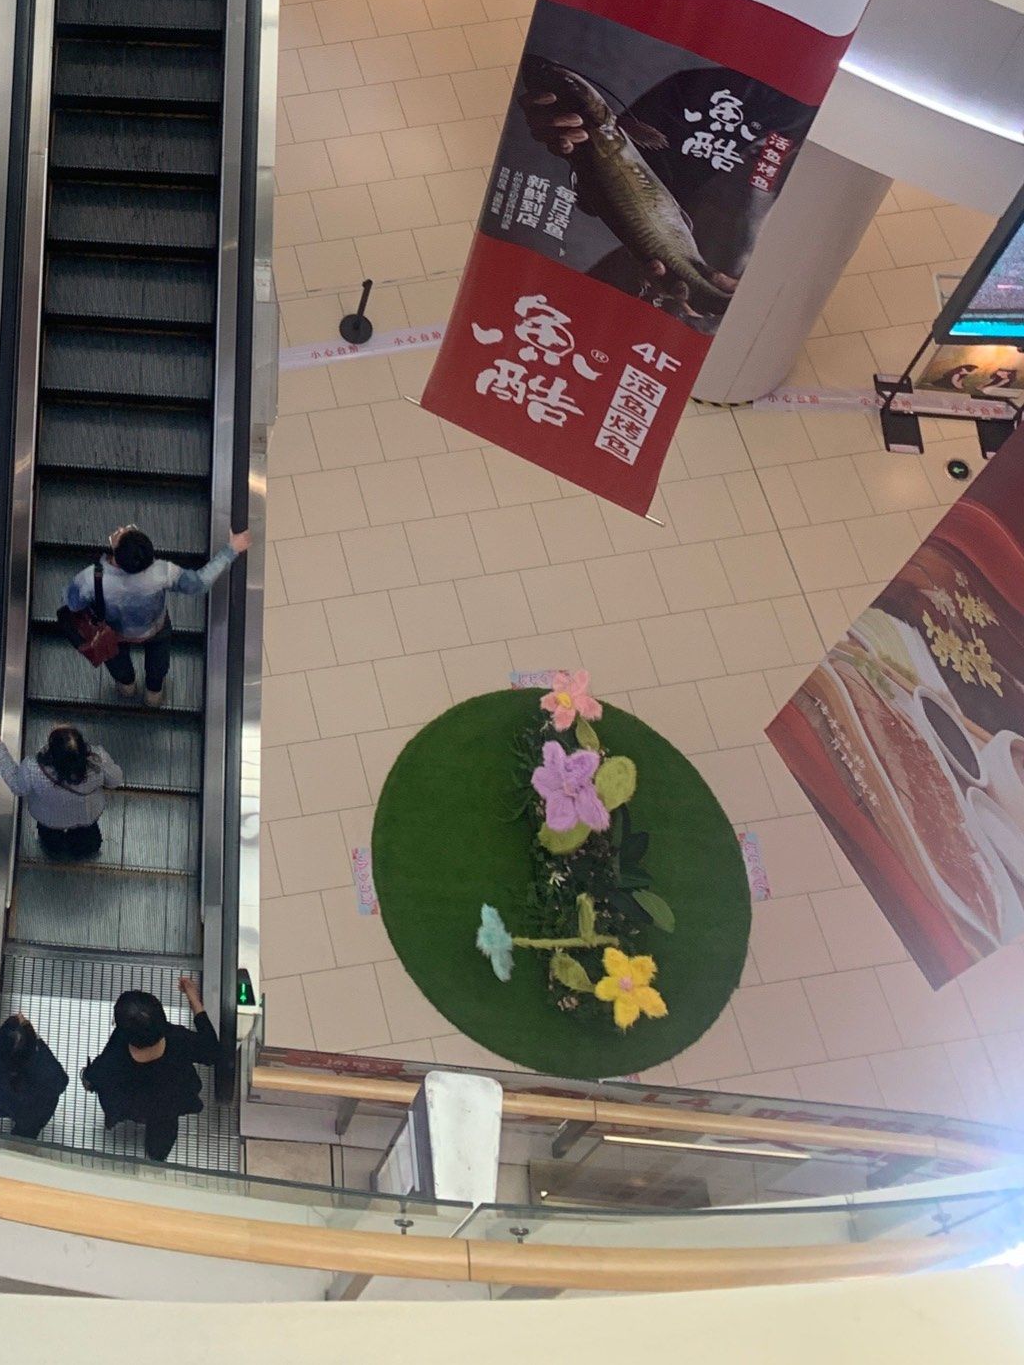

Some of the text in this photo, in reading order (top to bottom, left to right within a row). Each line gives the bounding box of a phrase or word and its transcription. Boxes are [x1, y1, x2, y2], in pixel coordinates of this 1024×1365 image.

[750, 133, 791, 192] 活鱼烤鱼
[516, 174, 551, 229] 新鲜到店
[542, 185, 578, 241] 每日活鱼
[631, 341, 682, 374] 4F
[597, 366, 665, 464] 活鱼烤鱼
